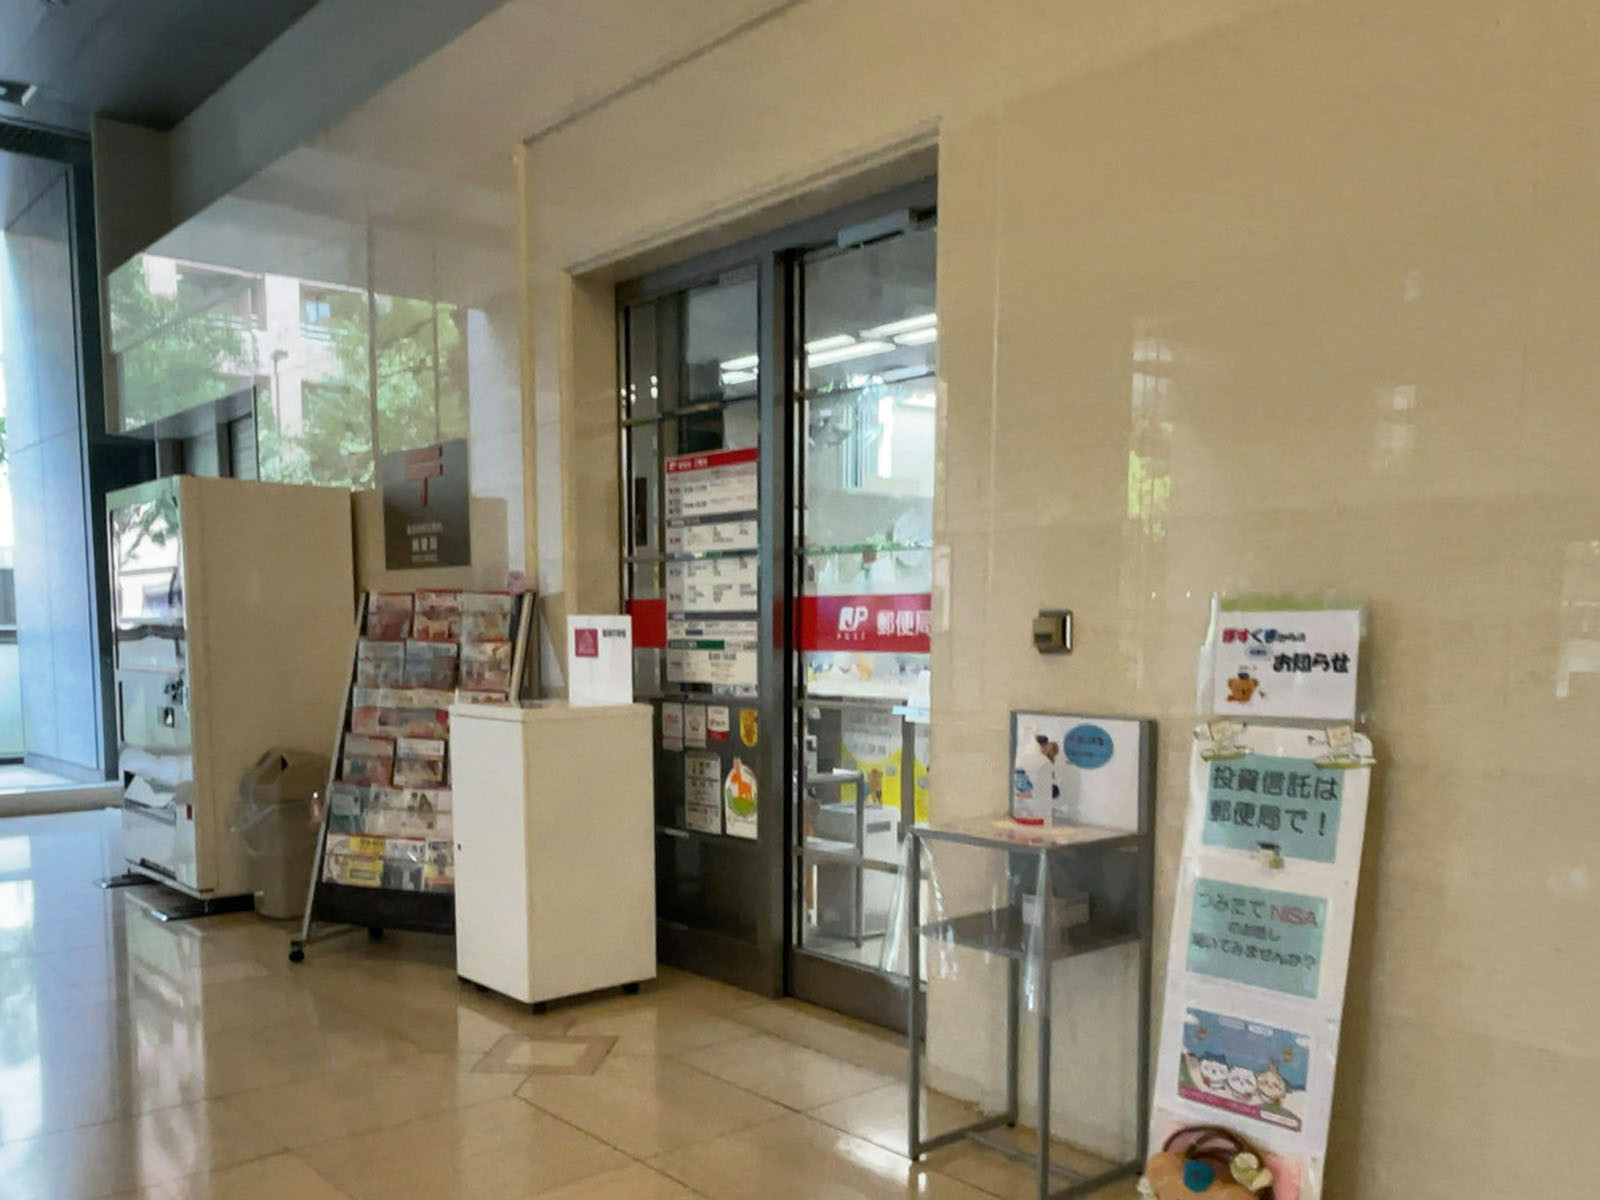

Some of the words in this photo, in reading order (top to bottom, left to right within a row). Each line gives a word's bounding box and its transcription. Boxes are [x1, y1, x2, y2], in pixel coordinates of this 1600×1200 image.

[838, 605, 869, 632] JP
[1272, 652, 1350, 674] お知らせ
[1212, 765, 1339, 801] 投資信託は
